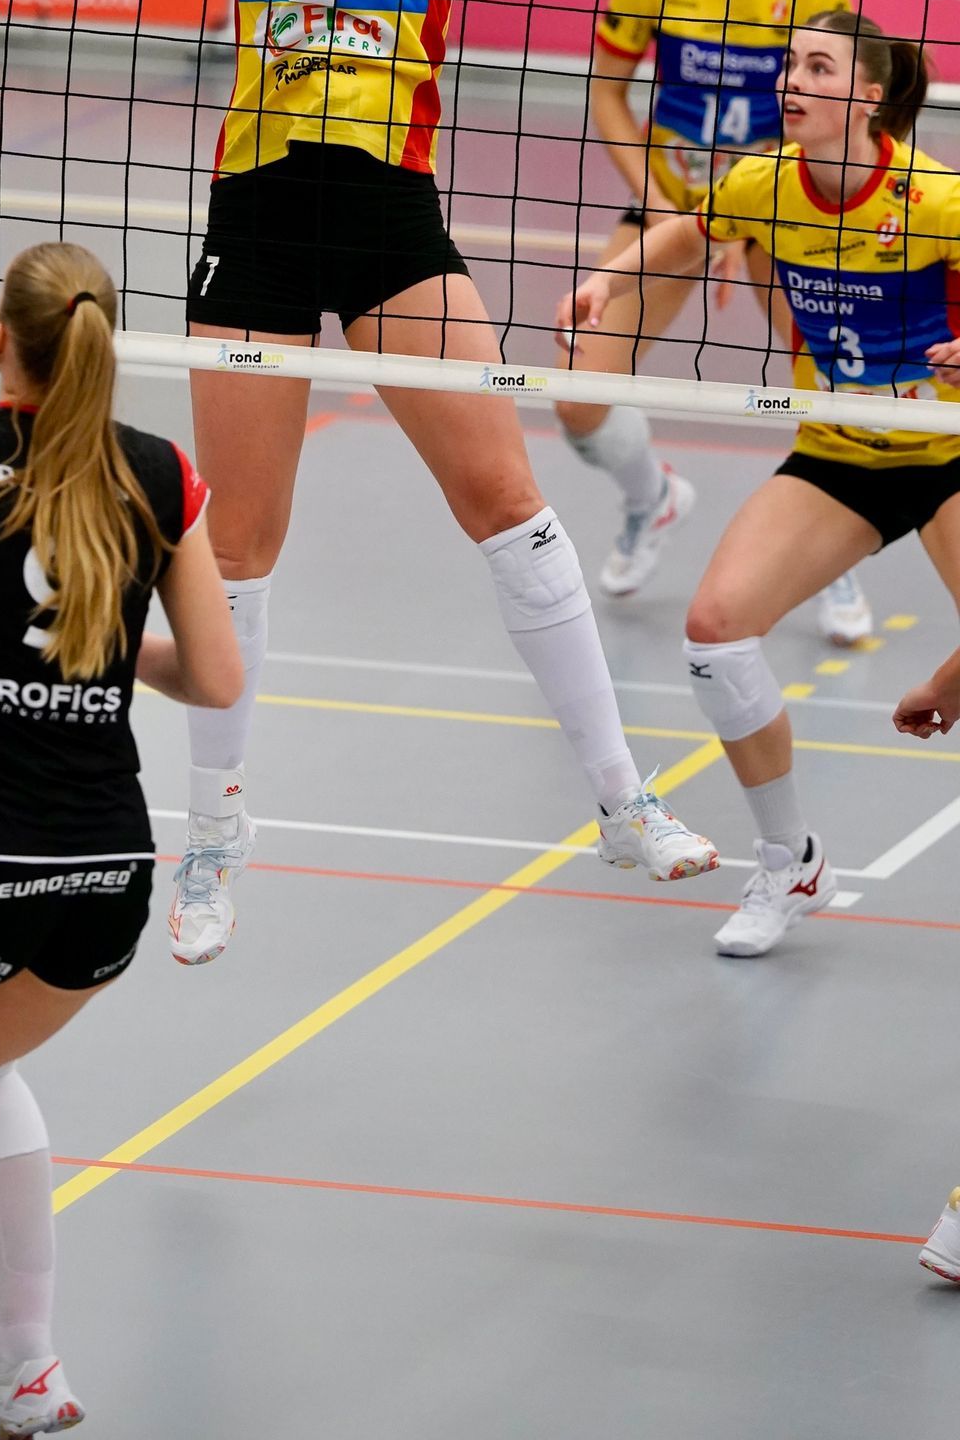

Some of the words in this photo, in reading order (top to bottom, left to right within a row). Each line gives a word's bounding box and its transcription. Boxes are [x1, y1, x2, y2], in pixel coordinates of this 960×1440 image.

[306, 34, 381, 56] BAKERY
[680, 42, 777, 73] Draisma
[700, 93, 751, 145] 14
[199, 255, 220, 296] 7
[786, 270, 884, 302] Draisma
[790, 289, 855, 316] Bouw
[229, 352, 284, 364] rondom
[827, 325, 866, 379] 3
[492, 375, 548, 387] rondom
[757, 397, 813, 409] rondom
